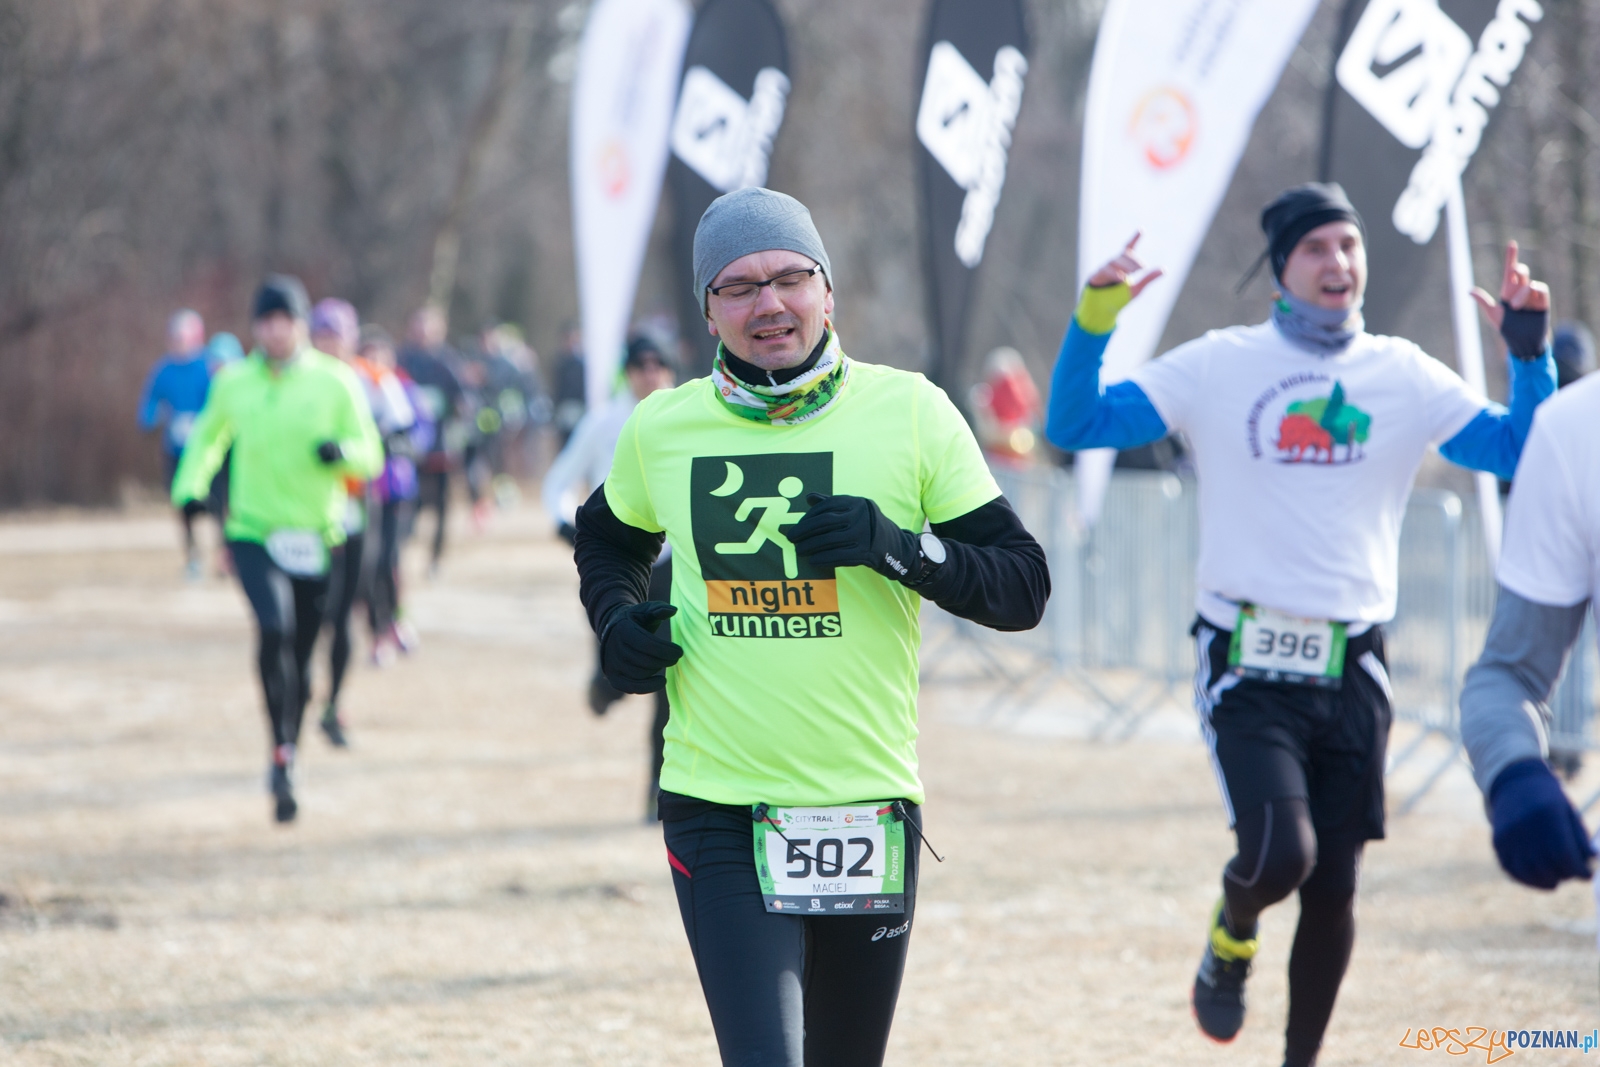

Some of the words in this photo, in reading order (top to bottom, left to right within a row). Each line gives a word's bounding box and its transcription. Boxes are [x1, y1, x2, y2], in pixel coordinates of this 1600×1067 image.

[730, 581, 815, 613] night
[709, 613, 842, 637] runners
[1254, 626, 1323, 660] 396
[786, 837, 874, 878] 502
[889, 845, 899, 882] Poznań
[812, 882, 847, 894] MACIEJ
